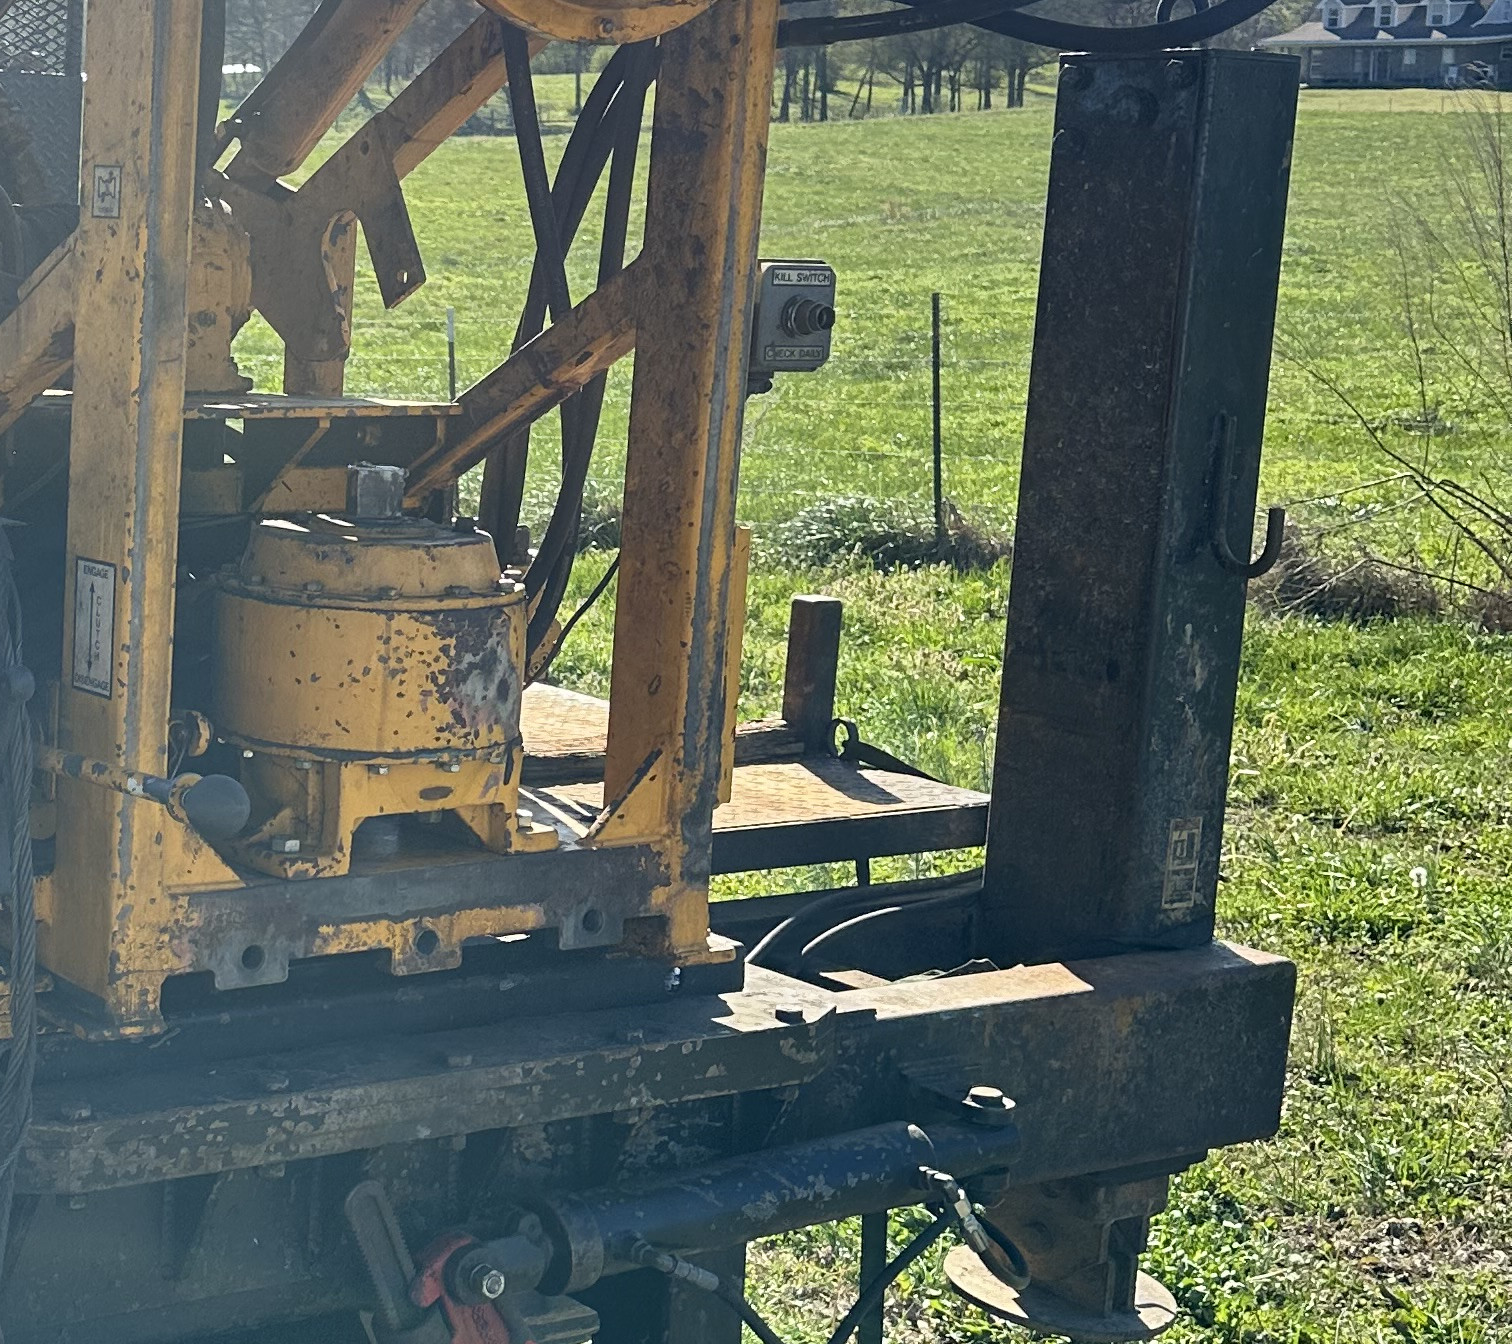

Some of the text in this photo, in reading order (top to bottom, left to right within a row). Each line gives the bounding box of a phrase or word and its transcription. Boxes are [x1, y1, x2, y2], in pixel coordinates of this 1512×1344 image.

[774, 271, 830, 283] KILL SWITCH
[766, 347, 821, 359] CHECK DAILY
[83, 564, 109, 580] ENGAGE
[93, 595, 103, 662] CLUTCH
